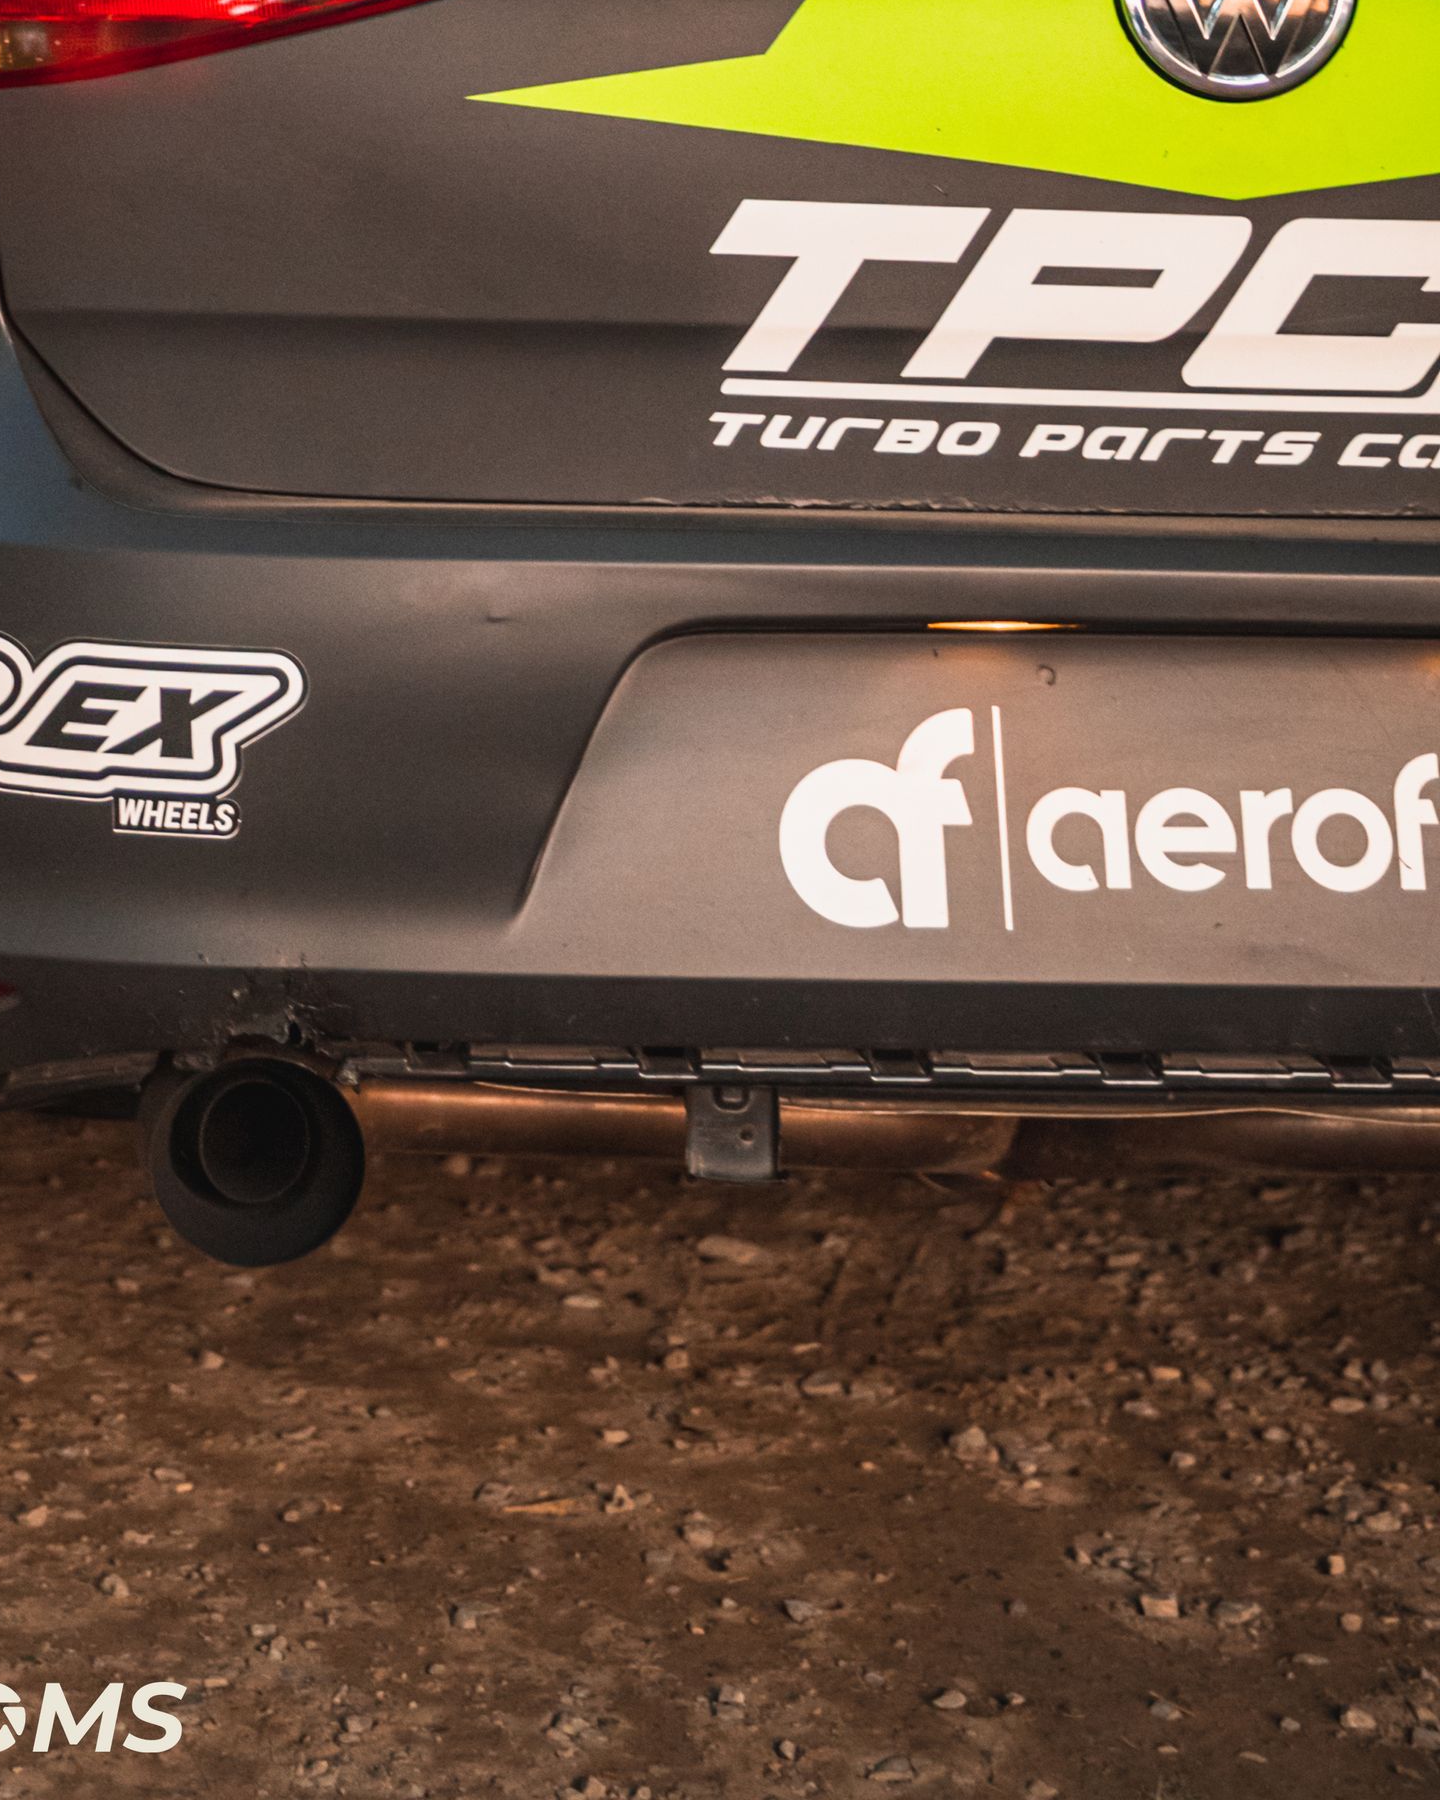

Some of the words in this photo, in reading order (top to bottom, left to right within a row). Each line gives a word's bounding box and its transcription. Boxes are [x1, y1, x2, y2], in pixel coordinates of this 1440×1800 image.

[708, 199, 1440, 392] TPC
[116, 797, 237, 833] WHEELS
[1026, 752, 1440, 893] aerof
